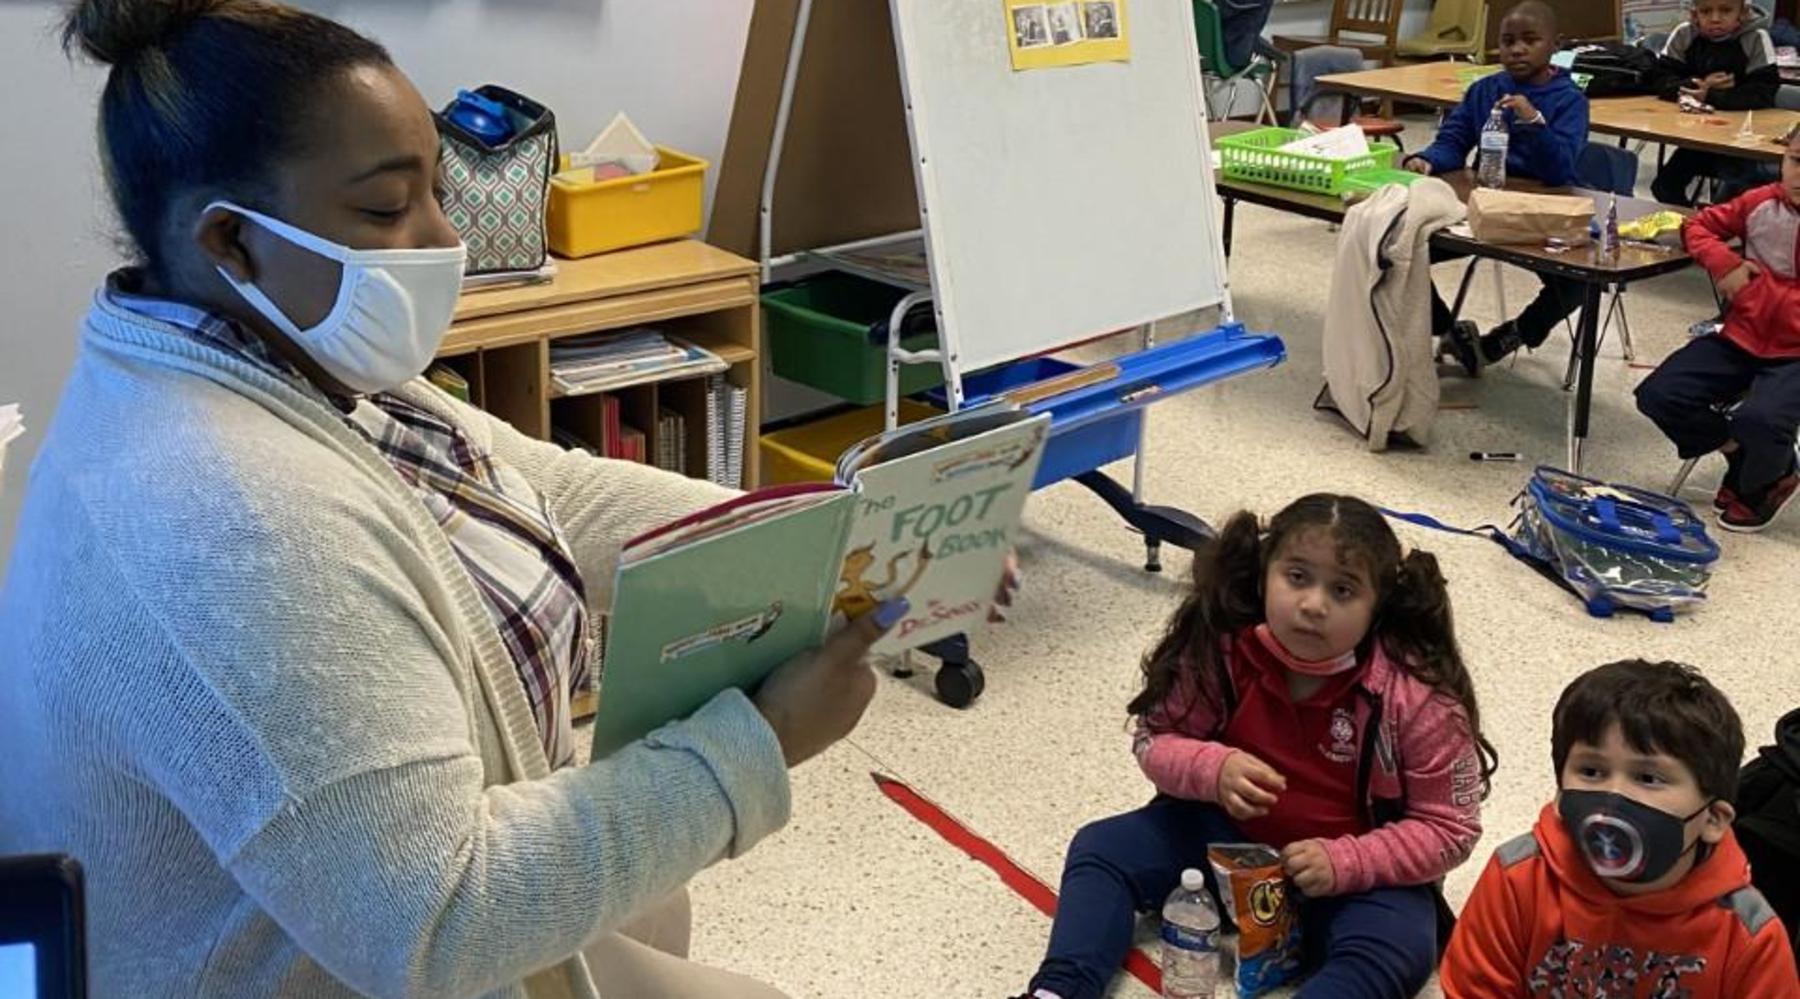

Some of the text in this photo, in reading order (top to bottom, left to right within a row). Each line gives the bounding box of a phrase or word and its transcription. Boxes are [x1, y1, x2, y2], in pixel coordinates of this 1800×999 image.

[861, 495, 896, 515] The
[891, 483, 1013, 542] FOOT
[937, 528, 1005, 559] BOOK
